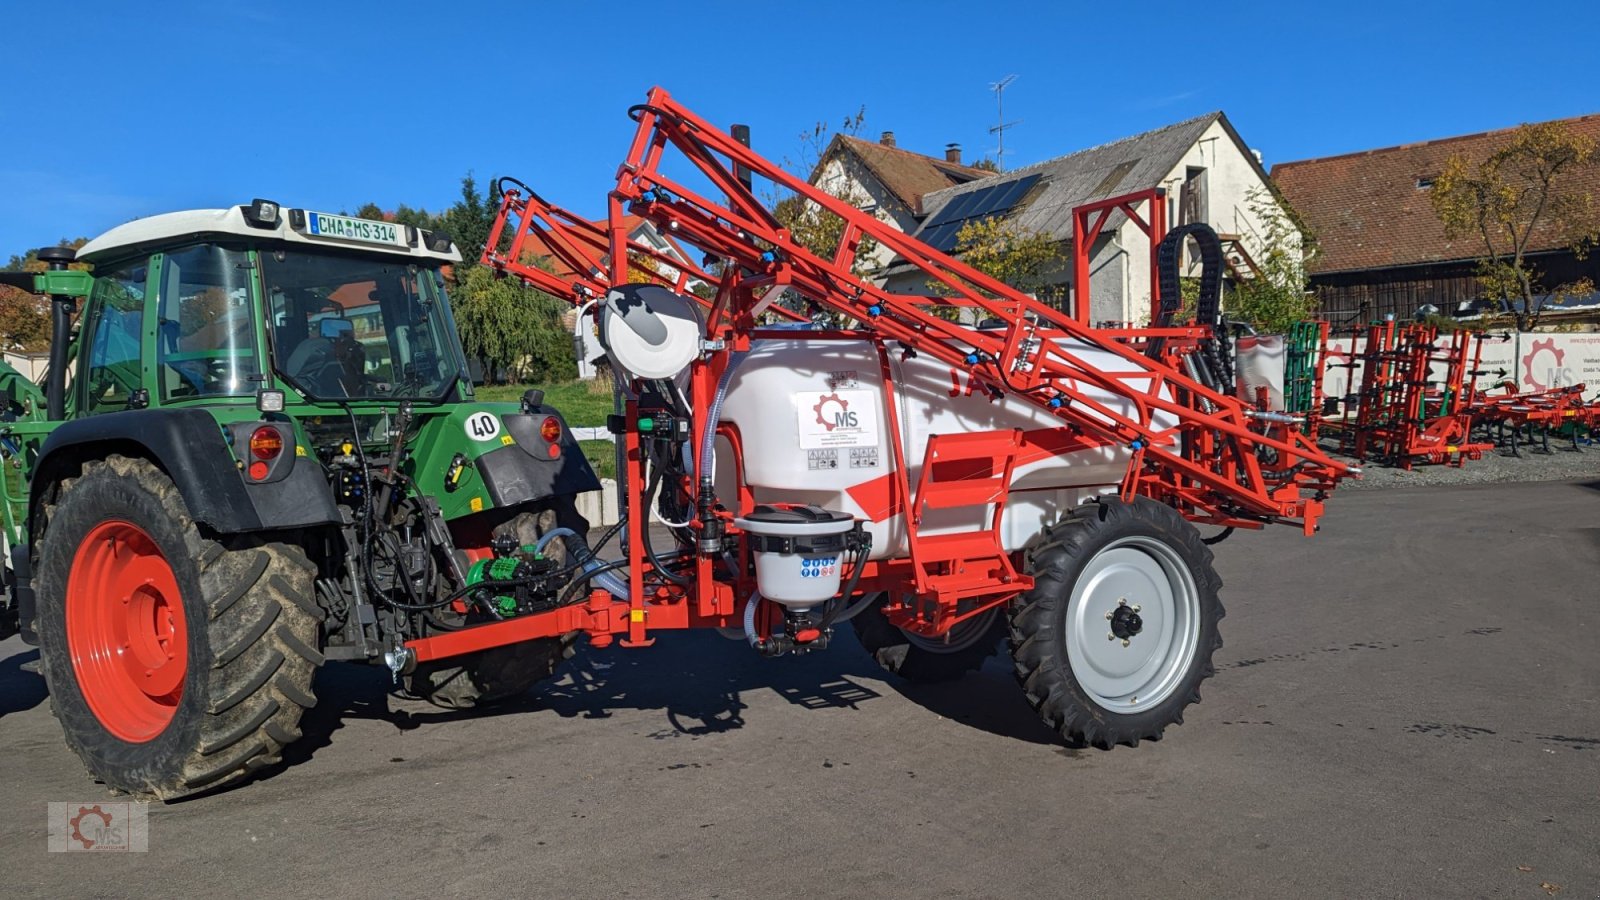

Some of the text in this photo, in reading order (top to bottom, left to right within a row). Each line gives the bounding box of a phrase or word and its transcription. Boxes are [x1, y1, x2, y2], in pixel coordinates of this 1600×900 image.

[318, 216, 345, 235] CHA
[471, 415, 496, 437] 40
[835, 411, 858, 427] MS
